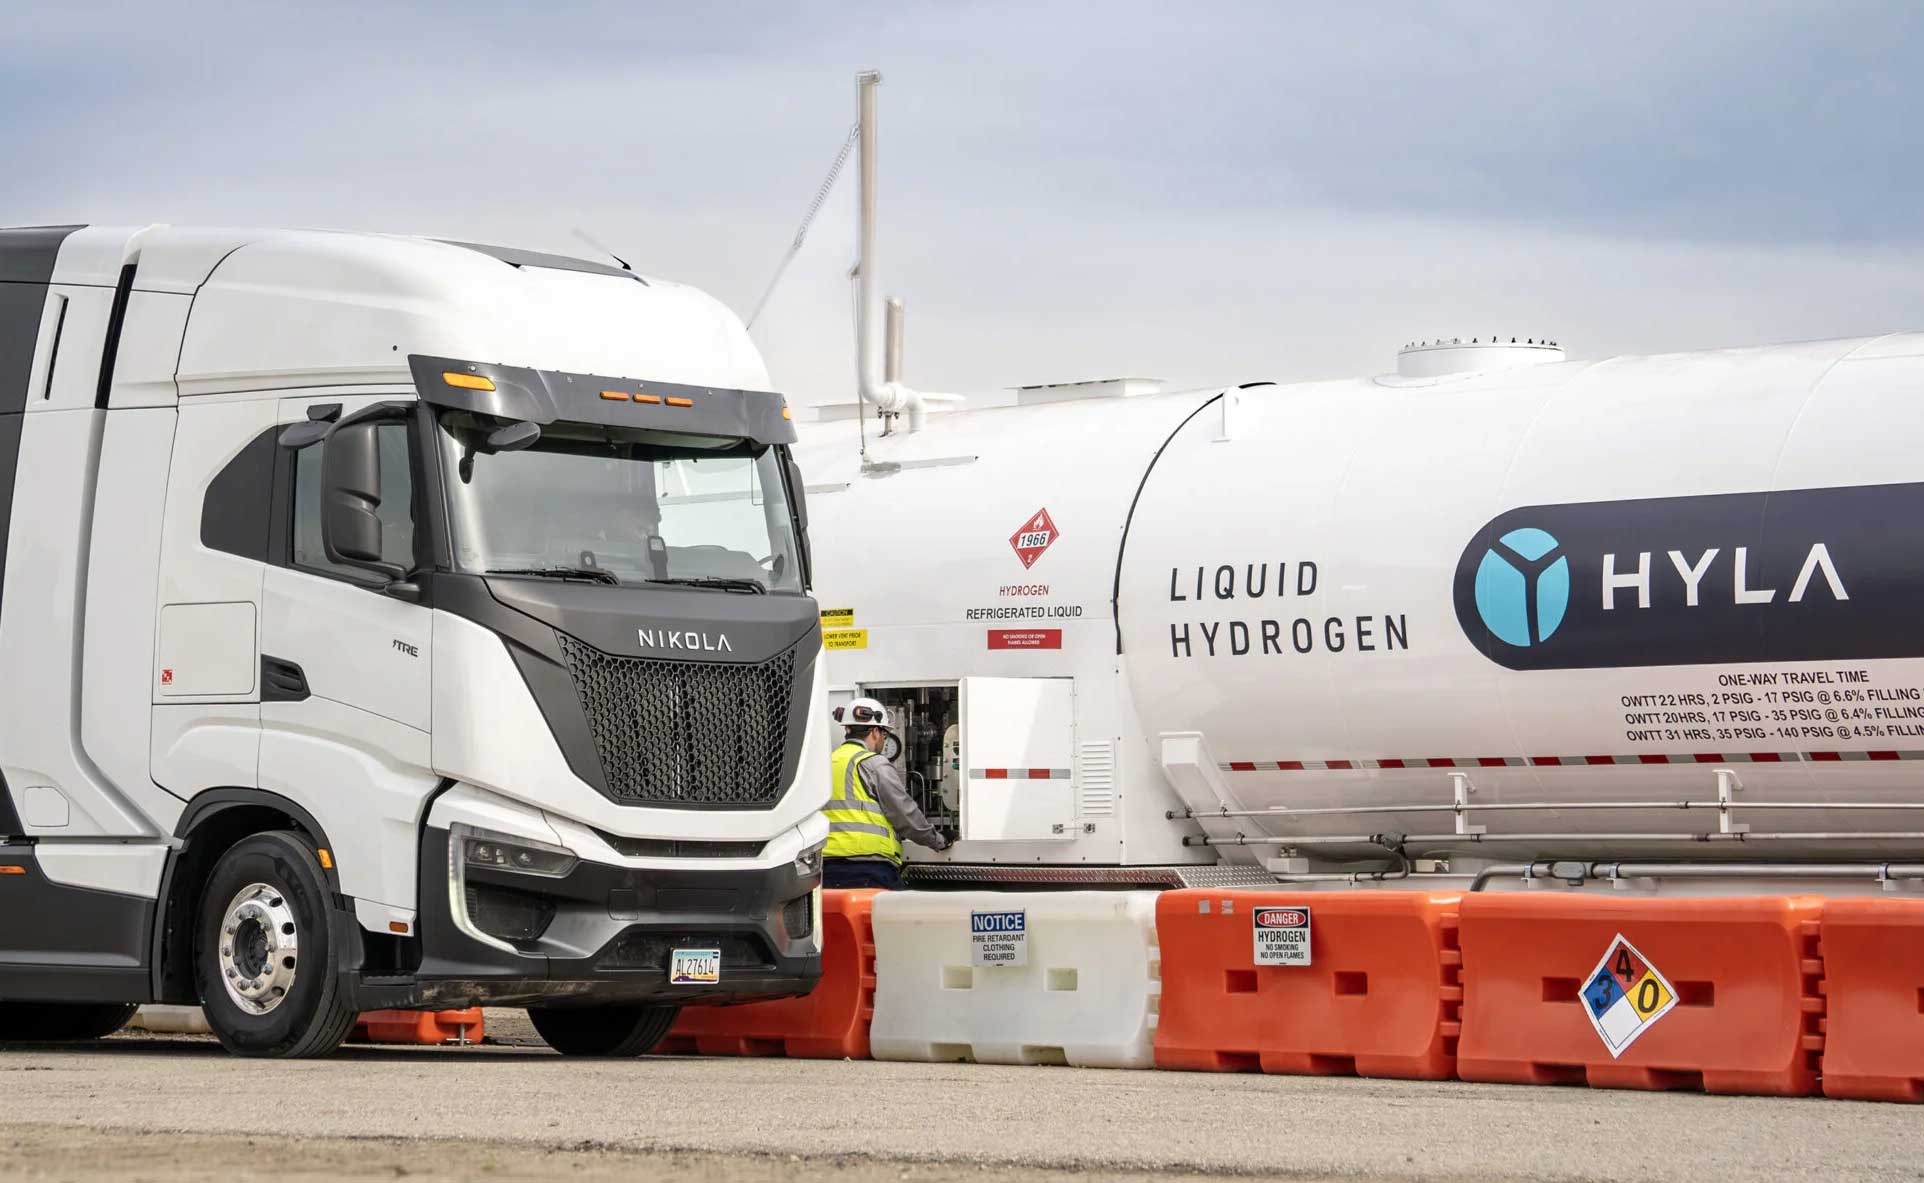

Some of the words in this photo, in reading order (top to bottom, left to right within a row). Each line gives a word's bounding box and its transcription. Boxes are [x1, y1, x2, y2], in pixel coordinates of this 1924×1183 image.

[1021, 532, 1047, 547] 1966
[1170, 561, 1318, 602] LIQUID
[1602, 543, 1850, 610] HYLA
[999, 585, 1050, 597] HYDROGEN
[966, 607, 1045, 620] REFRIGERATED
[1047, 605, 1083, 618] LIQUID
[638, 629, 732, 652] NIKOLA
[1170, 614, 1409, 658] HYDROGEN
[1718, 672, 1778, 687] ONE-WAY
[1781, 671, 1834, 684] TRAVEL
[1836, 670, 1869, 683] TIME
[1621, 695, 1657, 707] OWTT
[1658, 695, 1677, 706] 22
[1678, 693, 1710, 708] HRS,
[1711, 693, 1720, 705] 2
[1721, 692, 1754, 705] PSIG
[1764, 691, 1778, 703] 17
[1782, 690, 1814, 703] PSIG
[1817, 690, 1832, 705] @
[1833, 690, 1865, 702] 6.6%
[1867, 688, 1920, 701] FILLING
[1625, 713, 1661, 725] OWTT
[1712, 711, 1726, 722] 17
[1729, 710, 1761, 722] PSIG
[1771, 709, 1787, 721] 35
[1789, 708, 1822, 721] PSIG
[1824, 708, 1840, 723] @
[1840, 707, 1873, 720] 6.4%
[1874, 706, 1924, 719] FILLING
[1626, 730, 1662, 741] OWTT
[1665, 729, 1681, 740] 31
[1683, 728, 1716, 742] HRS,
[1716, 728, 1732, 740] 35
[1734, 727, 1766, 739] PSIG
[1776, 727, 1799, 738] 140
[1801, 726, 1833, 738] PSIG
[1836, 726, 1852, 740] @
[1854, 725, 1885, 737] 4.5%
[974, 914, 1023, 930] NOTICE
[1264, 913, 1299, 924] DANGER
[972, 935, 986, 943] FIRE
[987, 934, 1025, 942] RETARDANT
[1258, 930, 1306, 943] HYDROGEN
[982, 943, 1015, 952] CLOTHING
[983, 952, 1016, 961] REQUIRED
[675, 958, 714, 976] AL27614
[1616, 949, 1634, 982] 4
[1594, 974, 1613, 1009] 3
[1637, 978, 1660, 1014] 0
